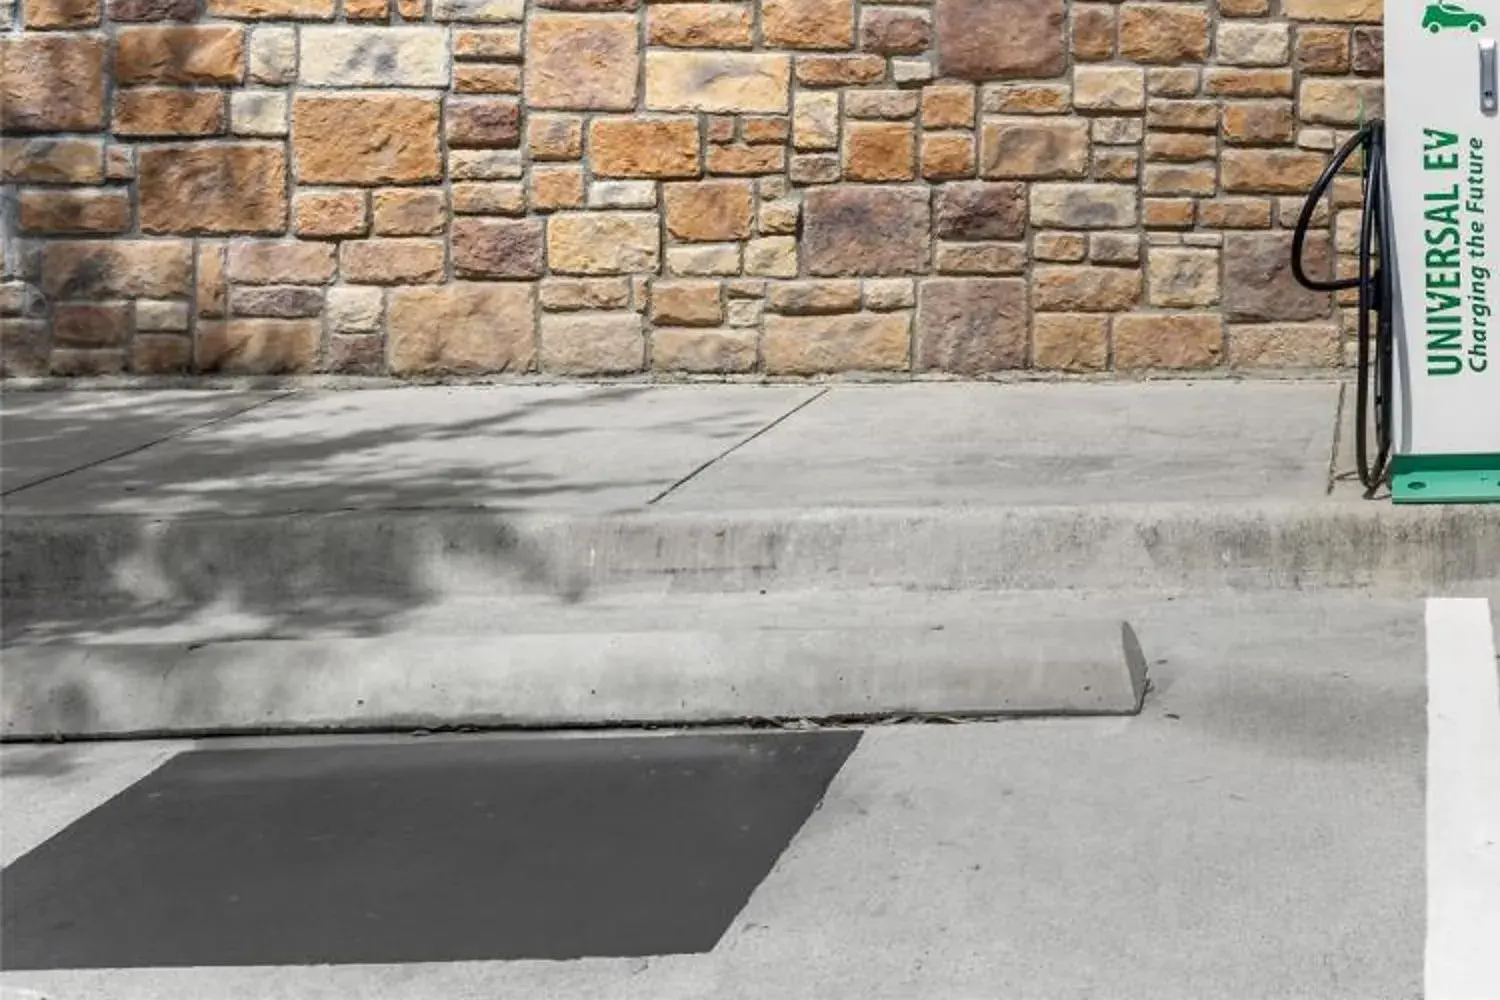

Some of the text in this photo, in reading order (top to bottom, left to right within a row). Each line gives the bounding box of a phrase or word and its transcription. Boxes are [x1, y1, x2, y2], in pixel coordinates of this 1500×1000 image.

[1423, 127, 1462, 376] UNIVERSAL EV
[1465, 137, 1491, 373] Charging the Future
